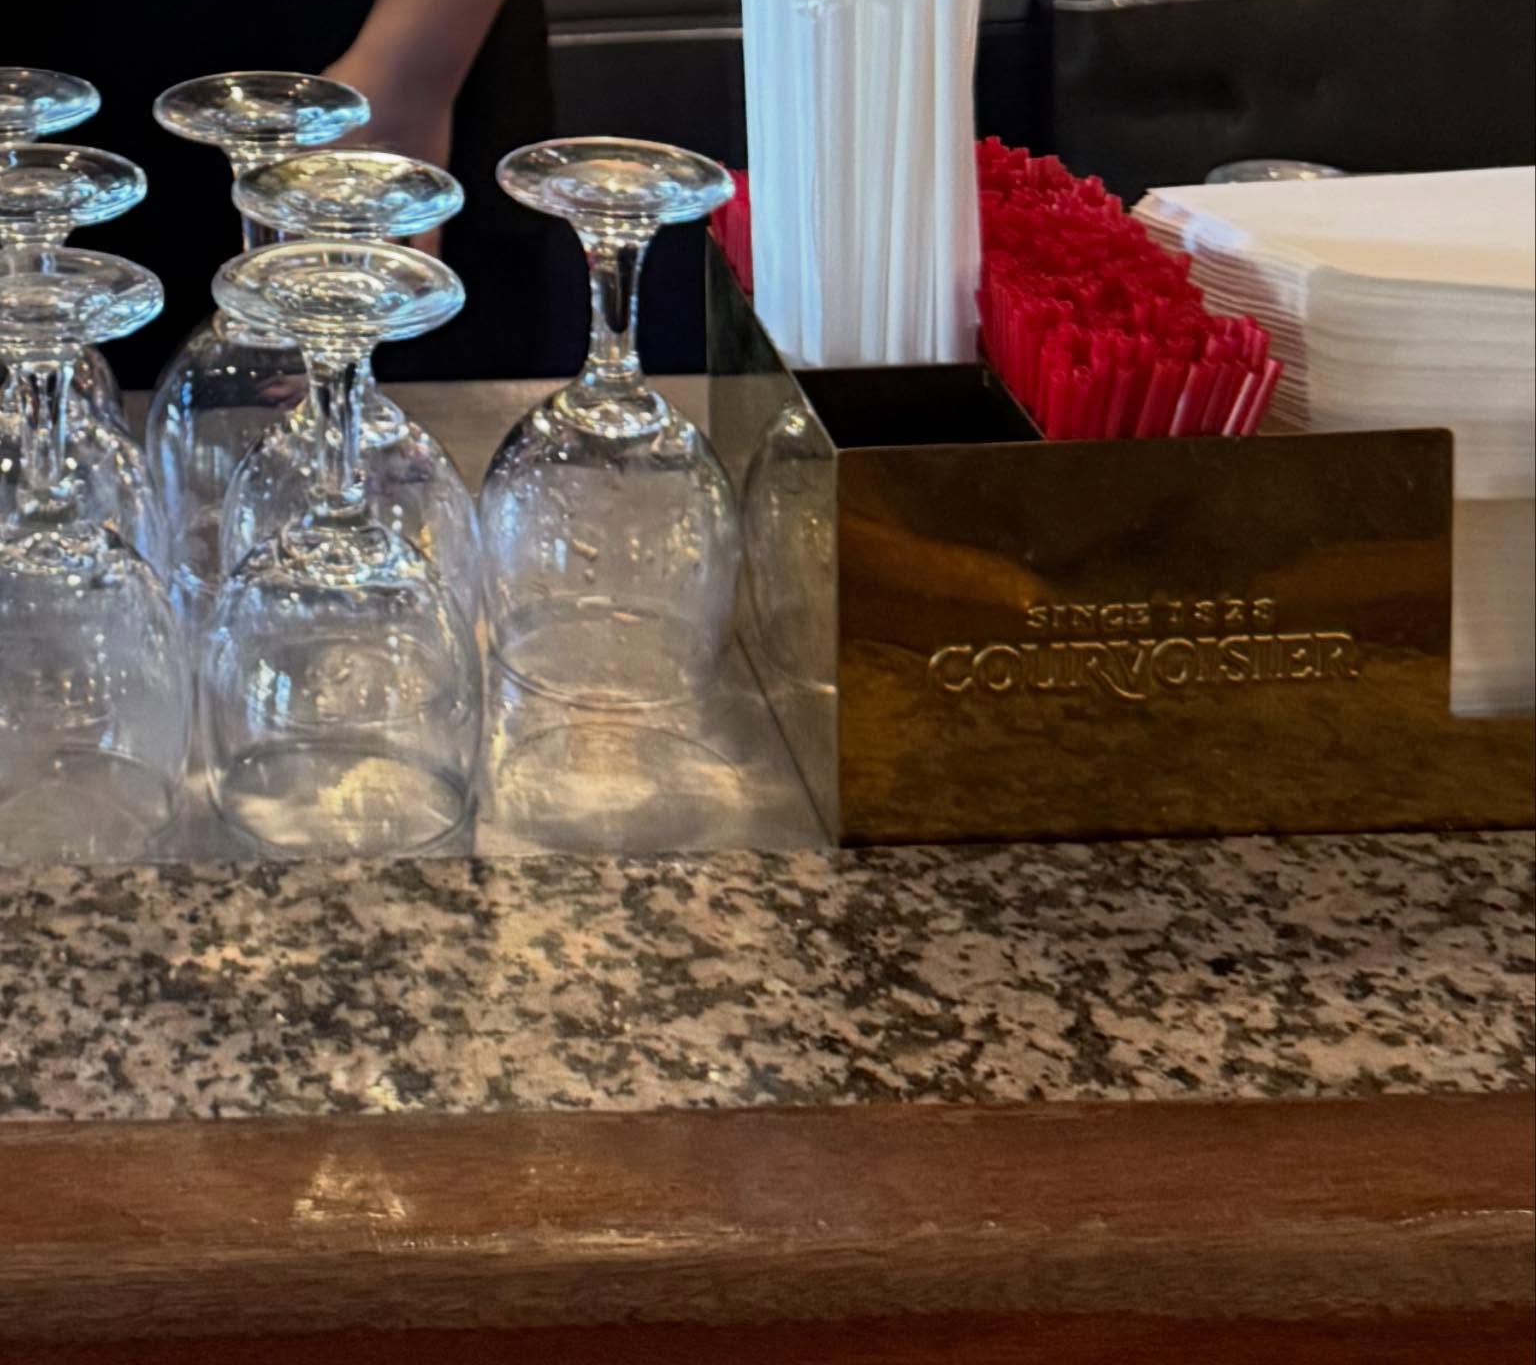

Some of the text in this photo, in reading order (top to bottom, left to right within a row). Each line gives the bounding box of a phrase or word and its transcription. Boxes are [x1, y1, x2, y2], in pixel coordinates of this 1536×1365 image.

[1026, 597, 1279, 629] SINCE 1828
[928, 629, 1361, 701] COURVOISIER
